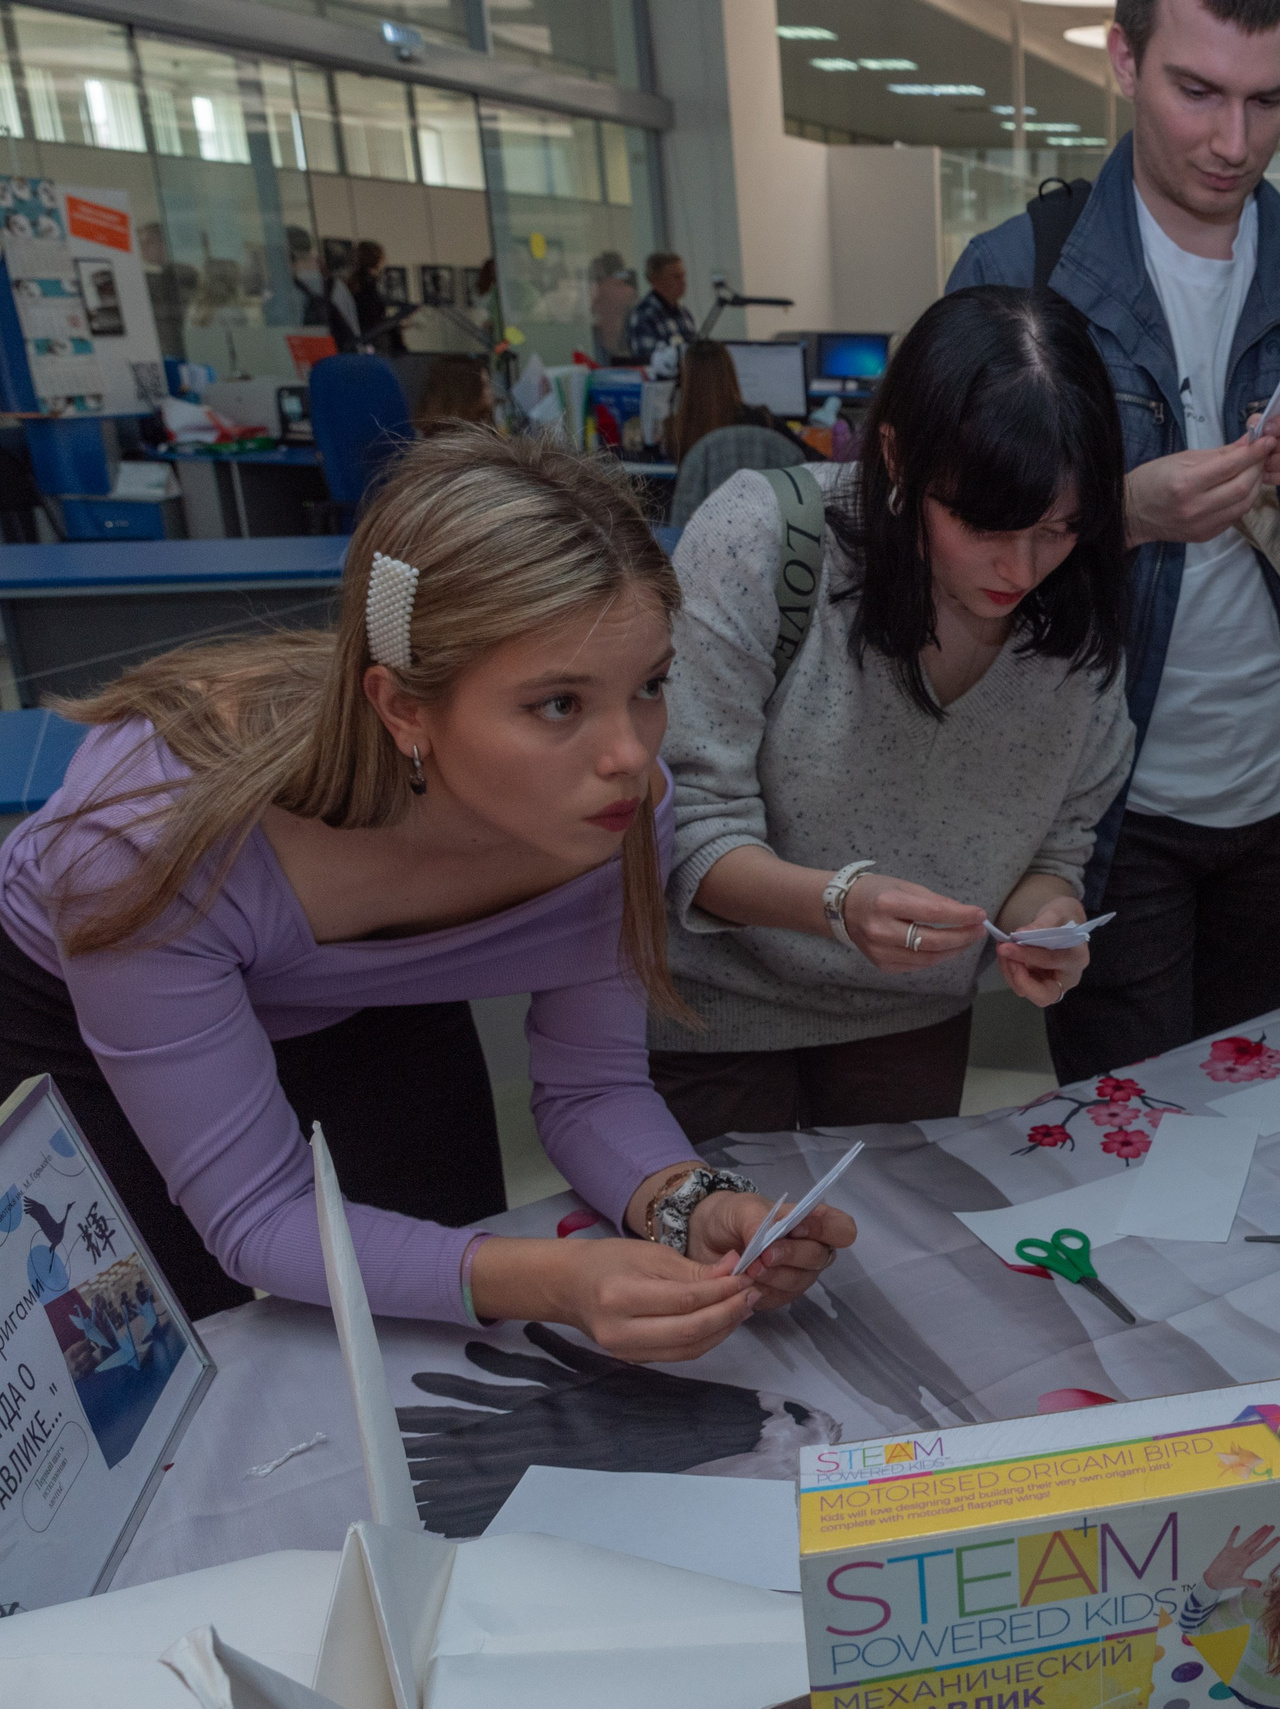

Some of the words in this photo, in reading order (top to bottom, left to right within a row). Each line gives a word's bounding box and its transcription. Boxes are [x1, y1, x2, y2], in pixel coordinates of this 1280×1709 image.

[776, 518, 821, 661] LOVE
[816, 1437, 944, 1473] STEAM
[817, 1463, 904, 1484] POWERED
[820, 1471, 999, 1511] MOTORISED
[1008, 1449, 1135, 1482] ORIGAMI
[1144, 1437, 1214, 1462] BIRD
[820, 1510, 845, 1522] Kids
[848, 1506, 867, 1519] will
[870, 1505, 892, 1517] love
[896, 1497, 951, 1513] designing
[954, 1493, 975, 1505] and
[979, 1483, 1024, 1499] building
[1027, 1480, 1053, 1491] their
[1055, 1477, 1077, 1488] very
[1079, 1473, 1103, 1483] own
[1105, 1465, 1146, 1479] origami
[820, 1518, 876, 1533] complete
[879, 1512, 904, 1524] with
[907, 1503, 964, 1520] motorised
[968, 1495, 1014, 1511] flapping
[1016, 1490, 1051, 1503] wings!
[826, 1512, 1179, 1637] STEAM
[831, 1607, 1070, 1675] POWERED
[833, 1641, 1133, 1709] МЕХАНИЧЕСКИЙ
